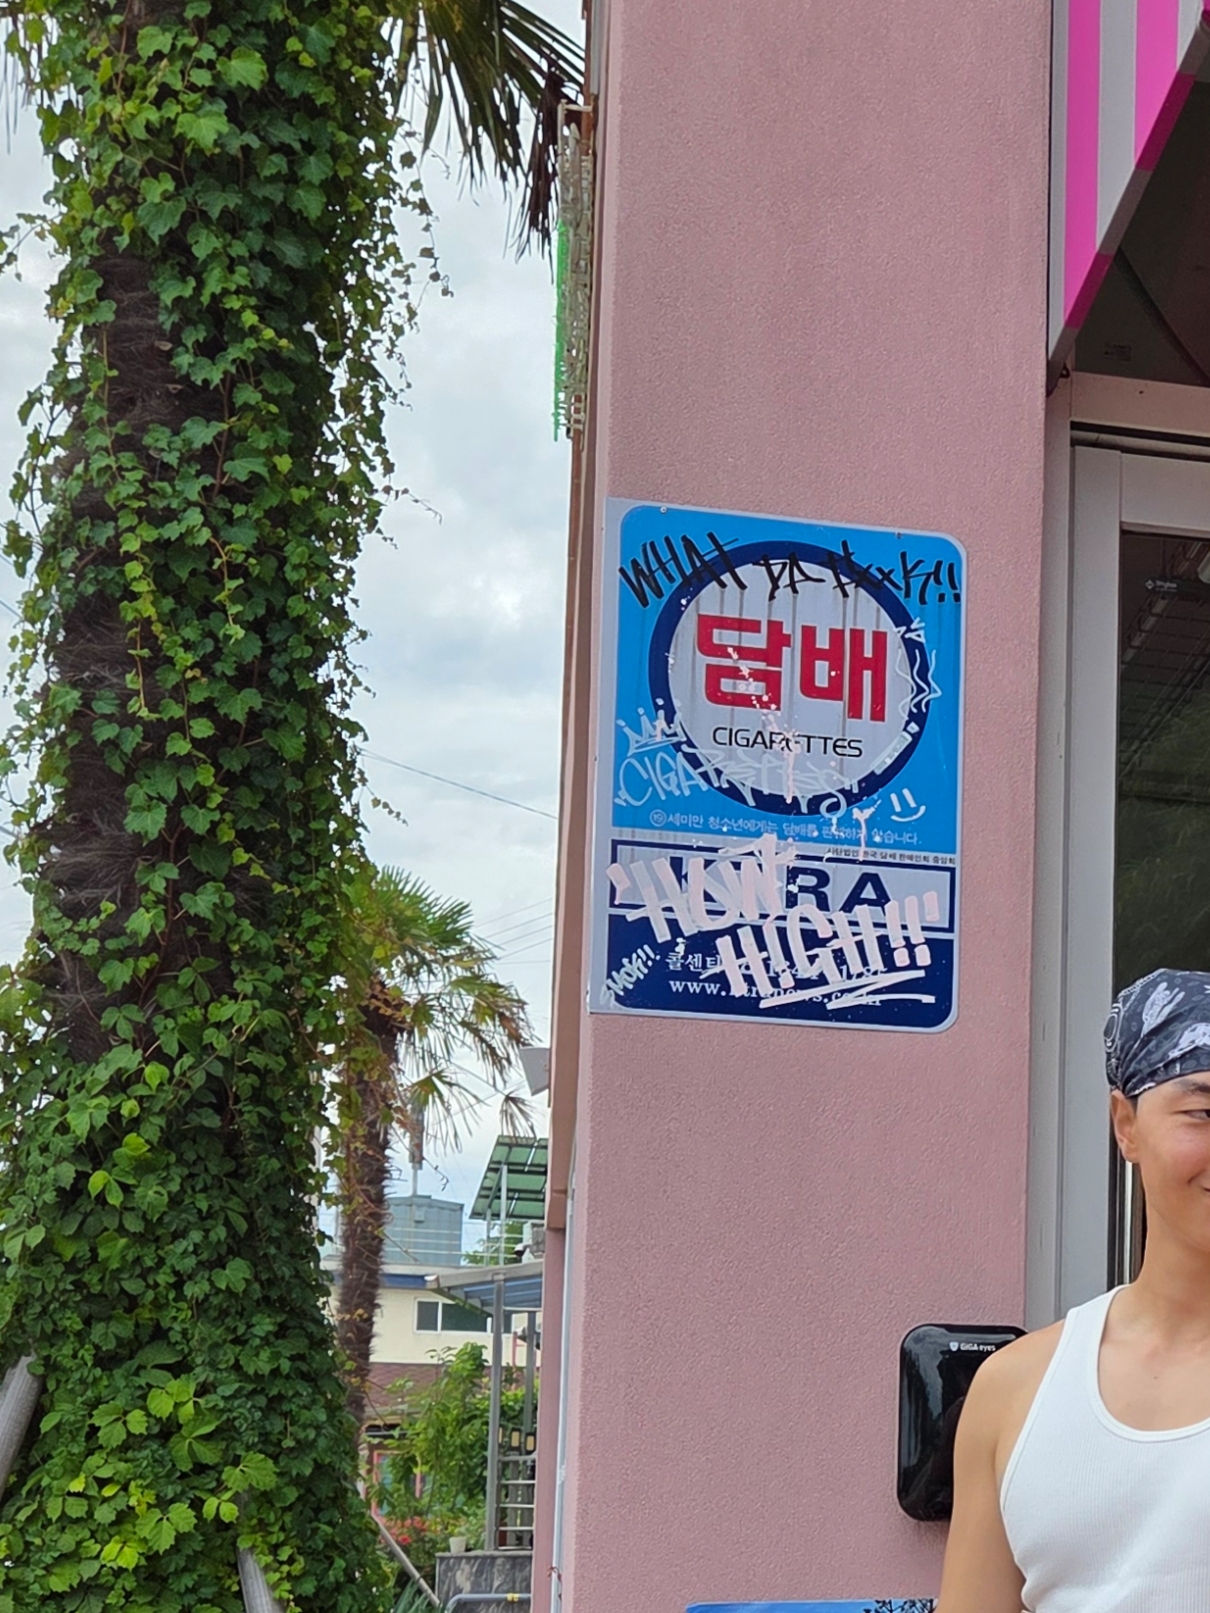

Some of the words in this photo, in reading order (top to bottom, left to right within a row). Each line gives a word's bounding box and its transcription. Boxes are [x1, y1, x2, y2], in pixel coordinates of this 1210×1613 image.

[618, 531, 748, 608] WHAT
[696, 613, 888, 723] 담배
[707, 813, 779, 834] 청소년에게는
